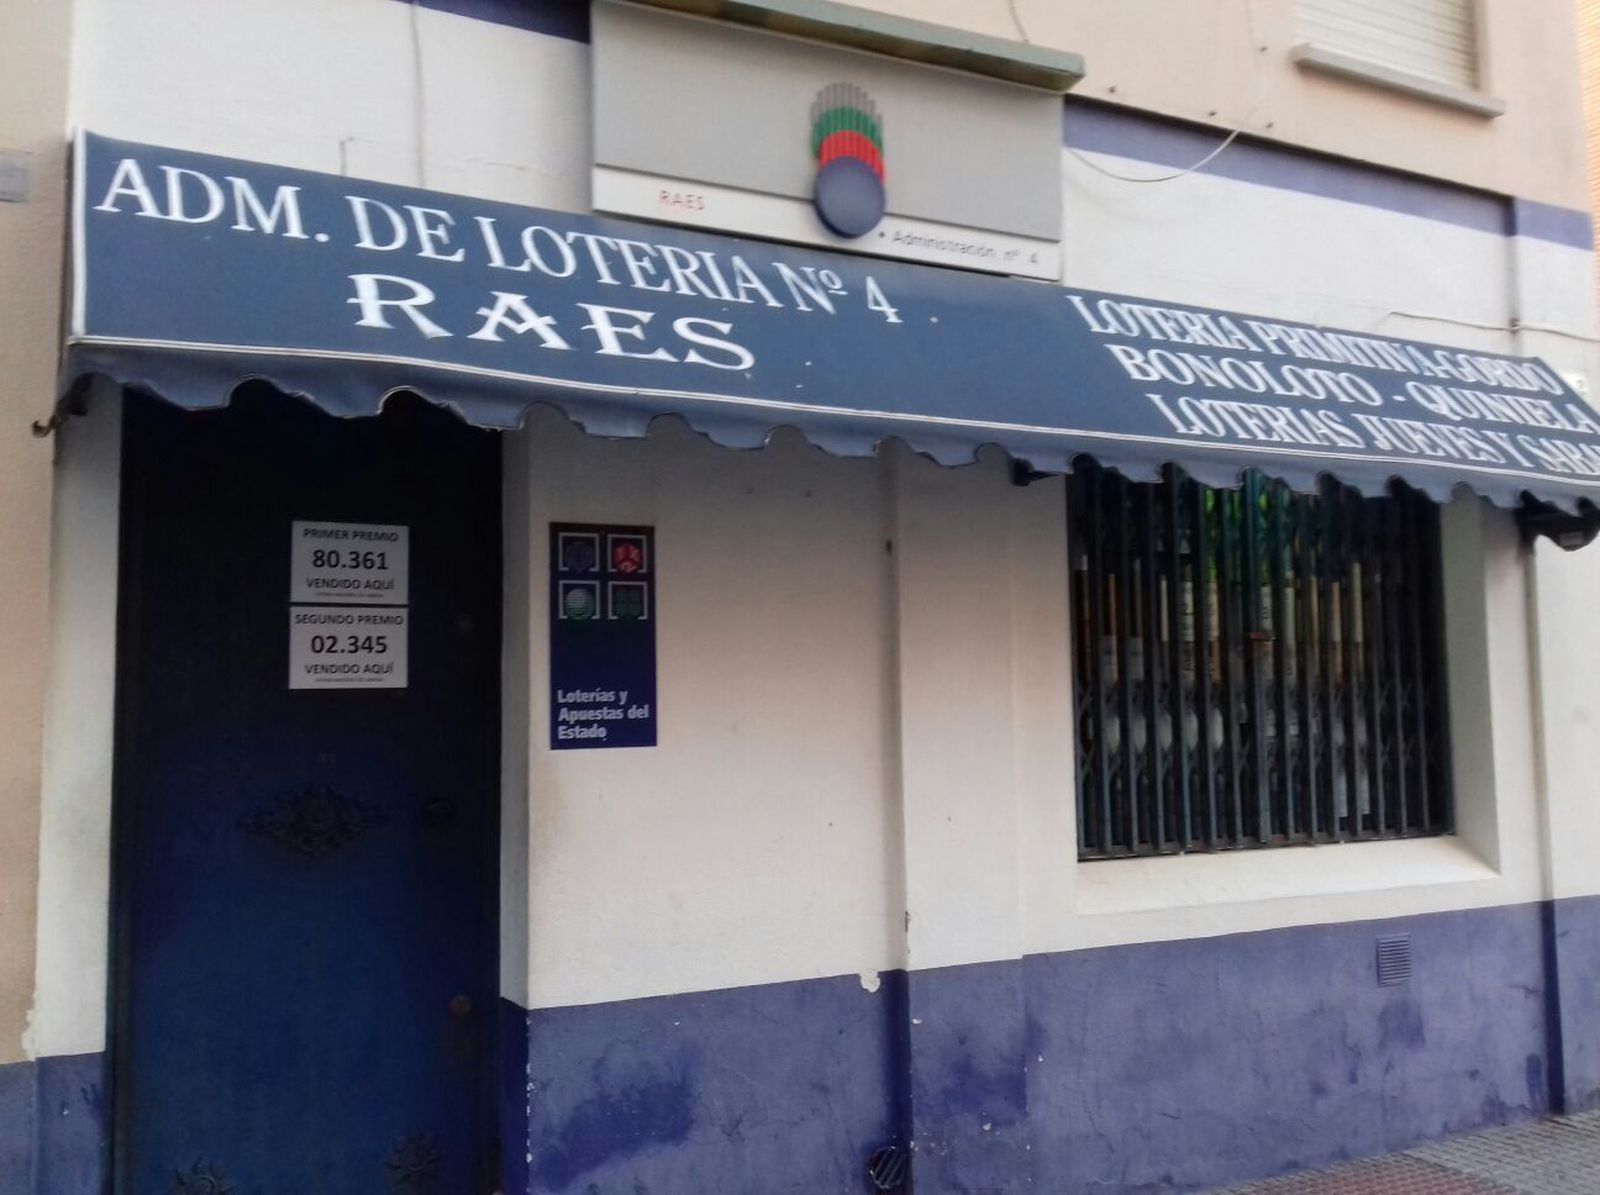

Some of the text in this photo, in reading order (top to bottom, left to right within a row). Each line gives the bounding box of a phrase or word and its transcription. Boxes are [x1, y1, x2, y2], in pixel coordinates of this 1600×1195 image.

[659, 189, 706, 212] RAES
[93, 158, 331, 243] ADM.
[345, 196, 464, 262] DE
[474, 216, 784, 308] LOTERIA
[866, 275, 903, 323] 4
[346, 274, 755, 371] RAES
[1066, 295, 1262, 352] LOTERIA
[1106, 343, 1384, 407] BONOLOTO
[1405, 381, 1600, 436] QUINIELA
[1145, 393, 1367, 449] LOTERIAS
[1350, 413, 1507, 464] JUEVES
[303, 528, 398, 542] PRIMER PREMIO
[312, 549, 388, 570] 80.361
[306, 578, 394, 590] VENDIDO AQUÍ
[295, 614, 403, 626] SEGUNDO PREMIO
[311, 635, 388, 654] 02.345
[304, 661, 394, 675] VENDIDO AQUÍ
[557, 688, 628, 705] Loterías y
[558, 704, 649, 723] Apuestas del
[557, 722, 607, 739] Estado
